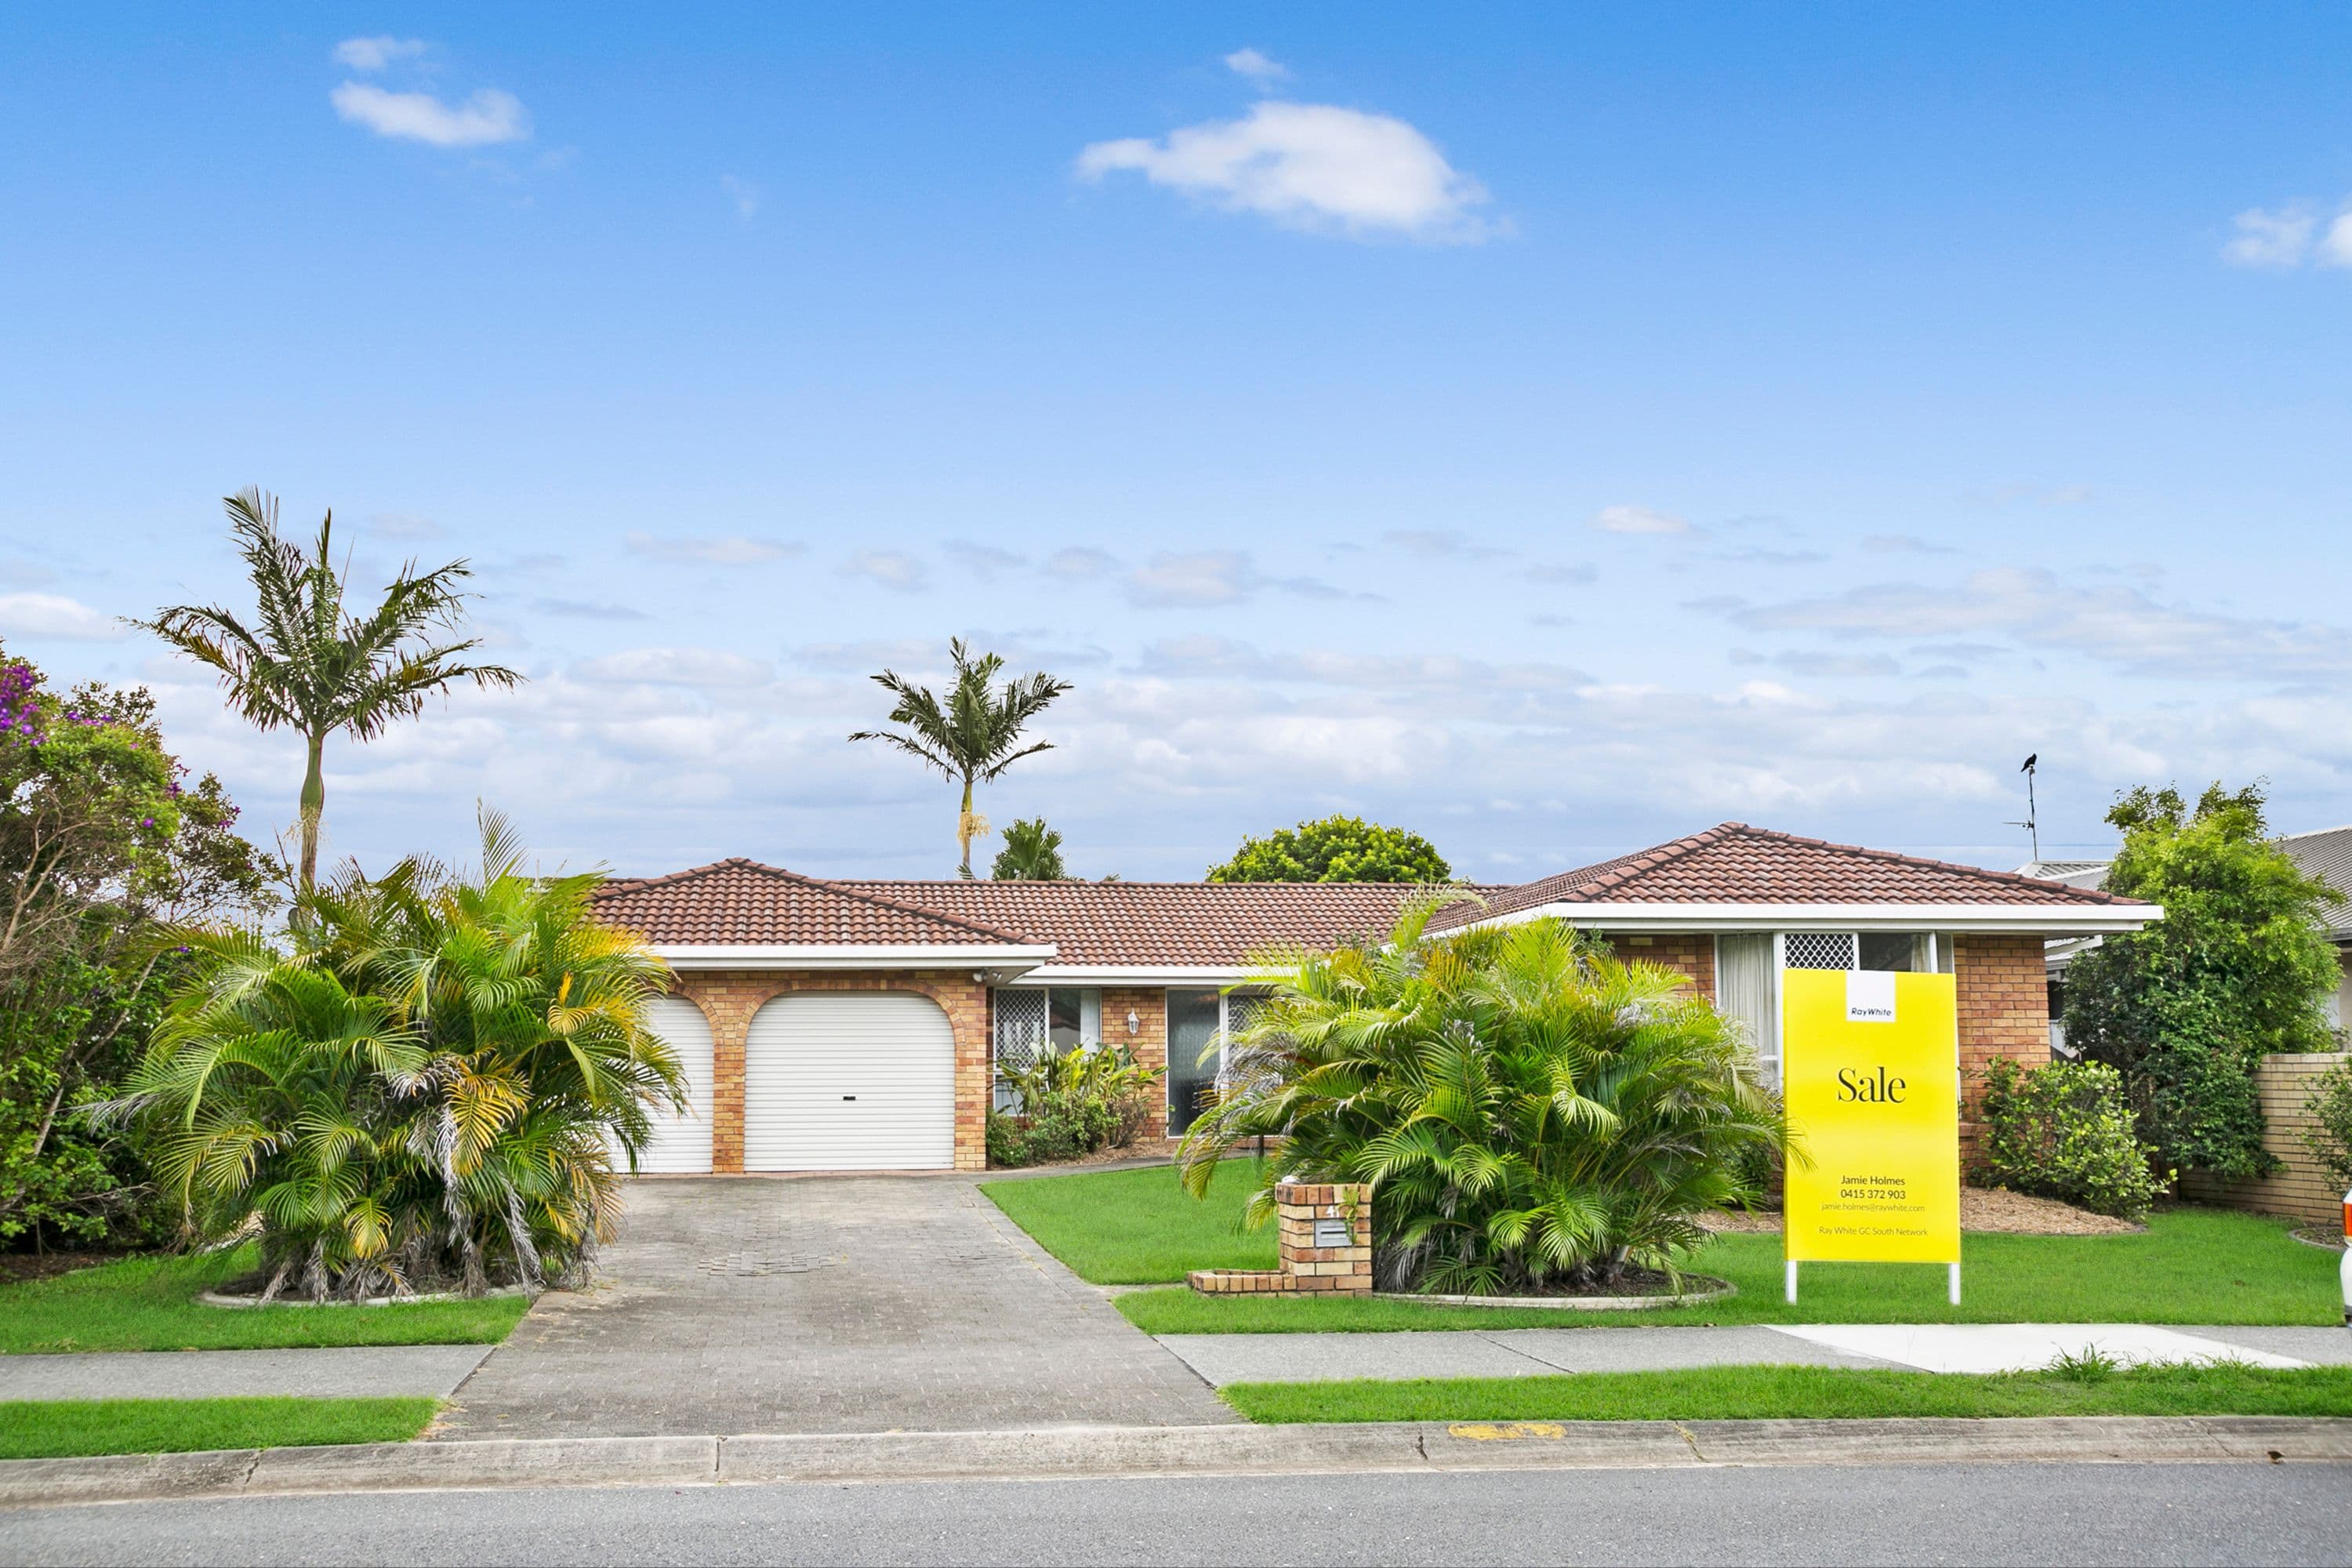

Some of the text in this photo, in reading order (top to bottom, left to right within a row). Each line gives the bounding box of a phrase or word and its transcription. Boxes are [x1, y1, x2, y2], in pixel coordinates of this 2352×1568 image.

[1838, 1066, 1907, 1103] Sale
[1841, 1174, 1905, 1185] Jamie Holmes
[1841, 1189, 1906, 1199] 0415 372 903
[1821, 1202, 1926, 1212] jamie.holmes@raywhite.com
[1819, 1226, 1832, 1235] Ray
[1835, 1226, 1857, 1235] White
[1872, 1227, 1894, 1236] South
